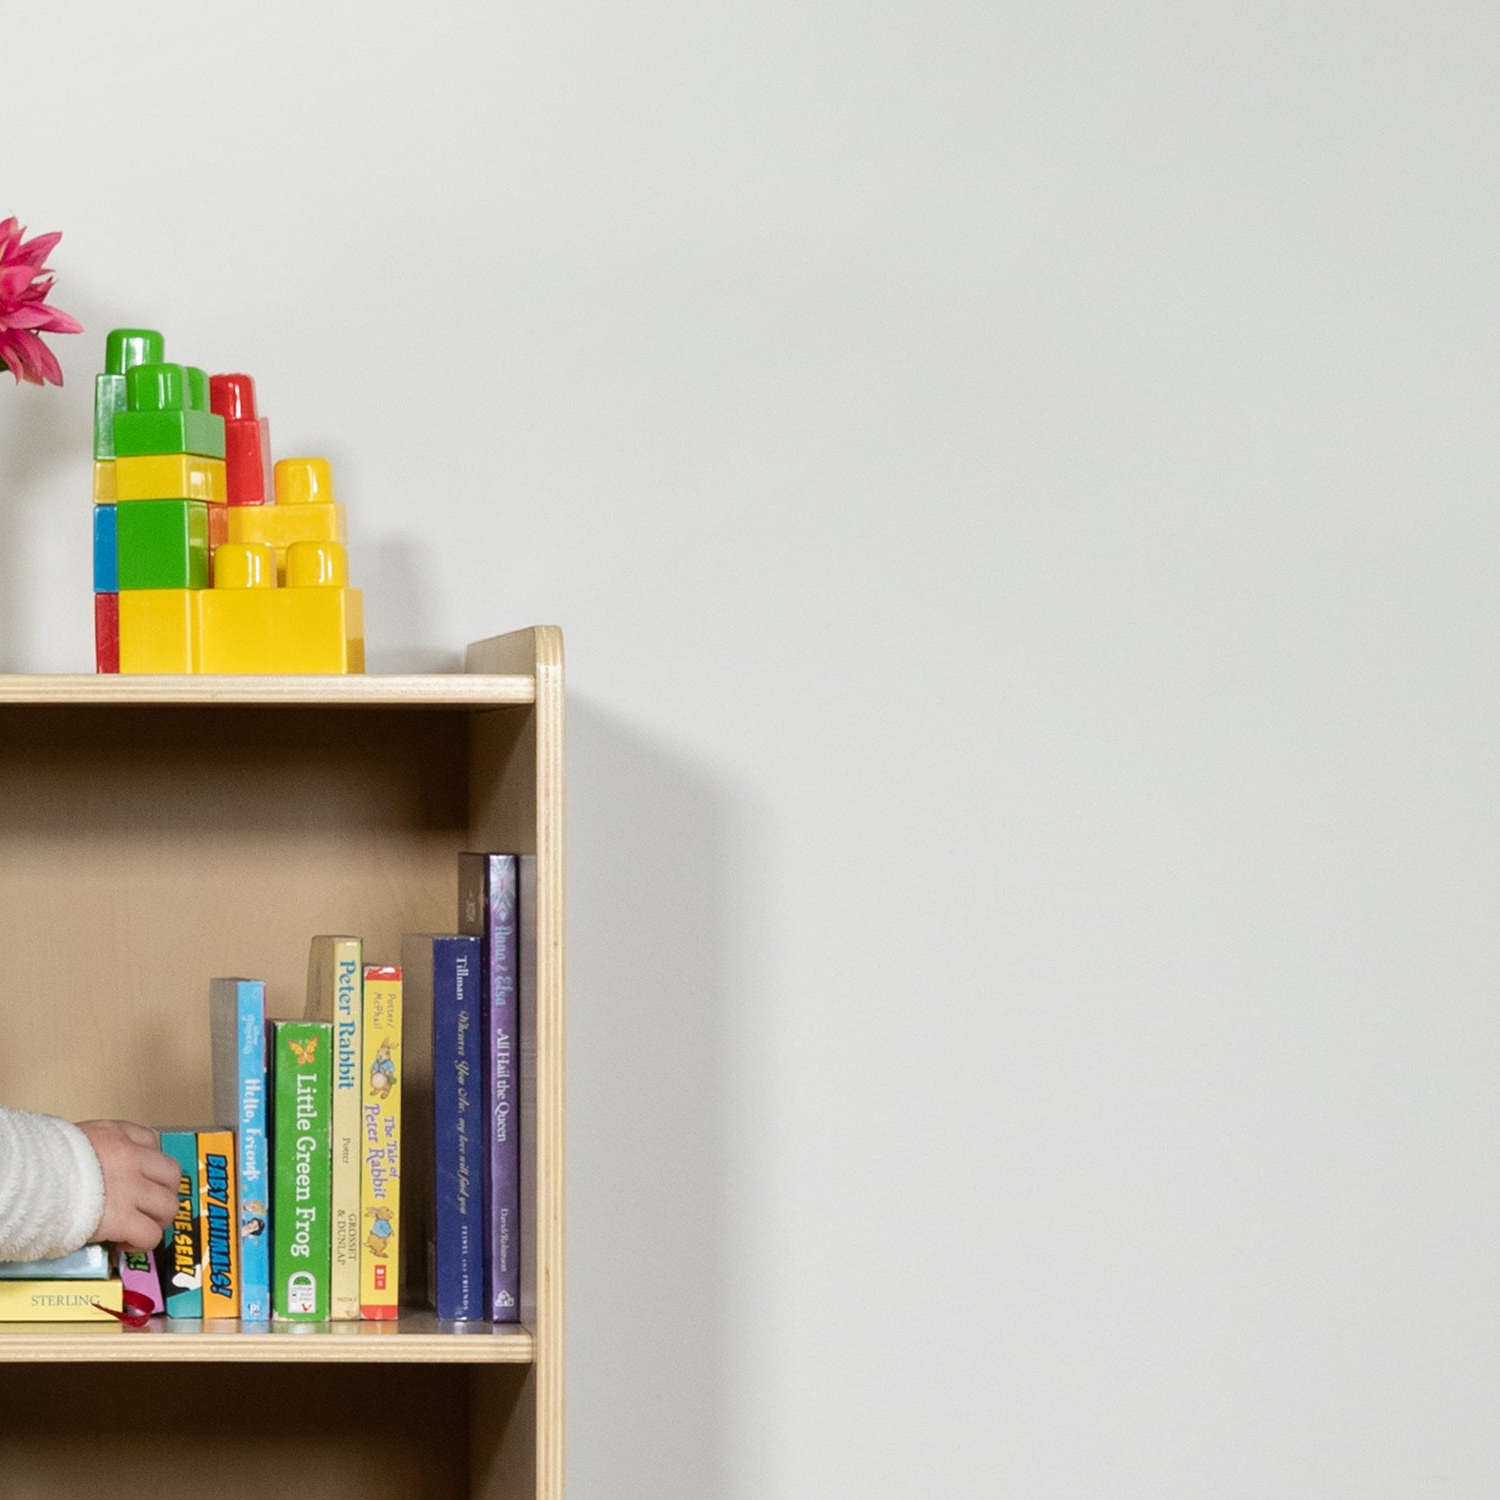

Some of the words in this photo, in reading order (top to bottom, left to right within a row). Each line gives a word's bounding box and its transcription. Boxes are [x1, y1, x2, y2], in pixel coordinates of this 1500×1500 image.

[338, 960, 357, 1016] Peter
[456, 955, 469, 1001] Tillman
[338, 1021, 356, 1089] Rabbit
[496, 1028, 510, 1049] All
[497, 1052, 511, 1078] Hail
[295, 1073, 318, 1131] Little
[497, 1080, 509, 1099] the
[363, 1103, 381, 1143] Peter
[383, 1116, 396, 1138] The
[494, 1102, 510, 1142] Queen
[295, 1135, 317, 1202] Green
[342, 1137, 351, 1165] Potter
[365, 1147, 388, 1199] Rabbit
[385, 1140, 398, 1163] Tale
[387, 1165, 401, 1180] of
[206, 1153, 229, 1205] BABY
[173, 1199, 192, 1232] THE
[290, 1206, 316, 1258] Frog
[348, 1213, 358, 1262] GROSSET
[173, 1233, 196, 1277] SEA!
[207, 1201, 233, 1299] ANIMALS!
[336, 1220, 346, 1266] DUNLAP
[31, 1295, 100, 1307] STERLING
